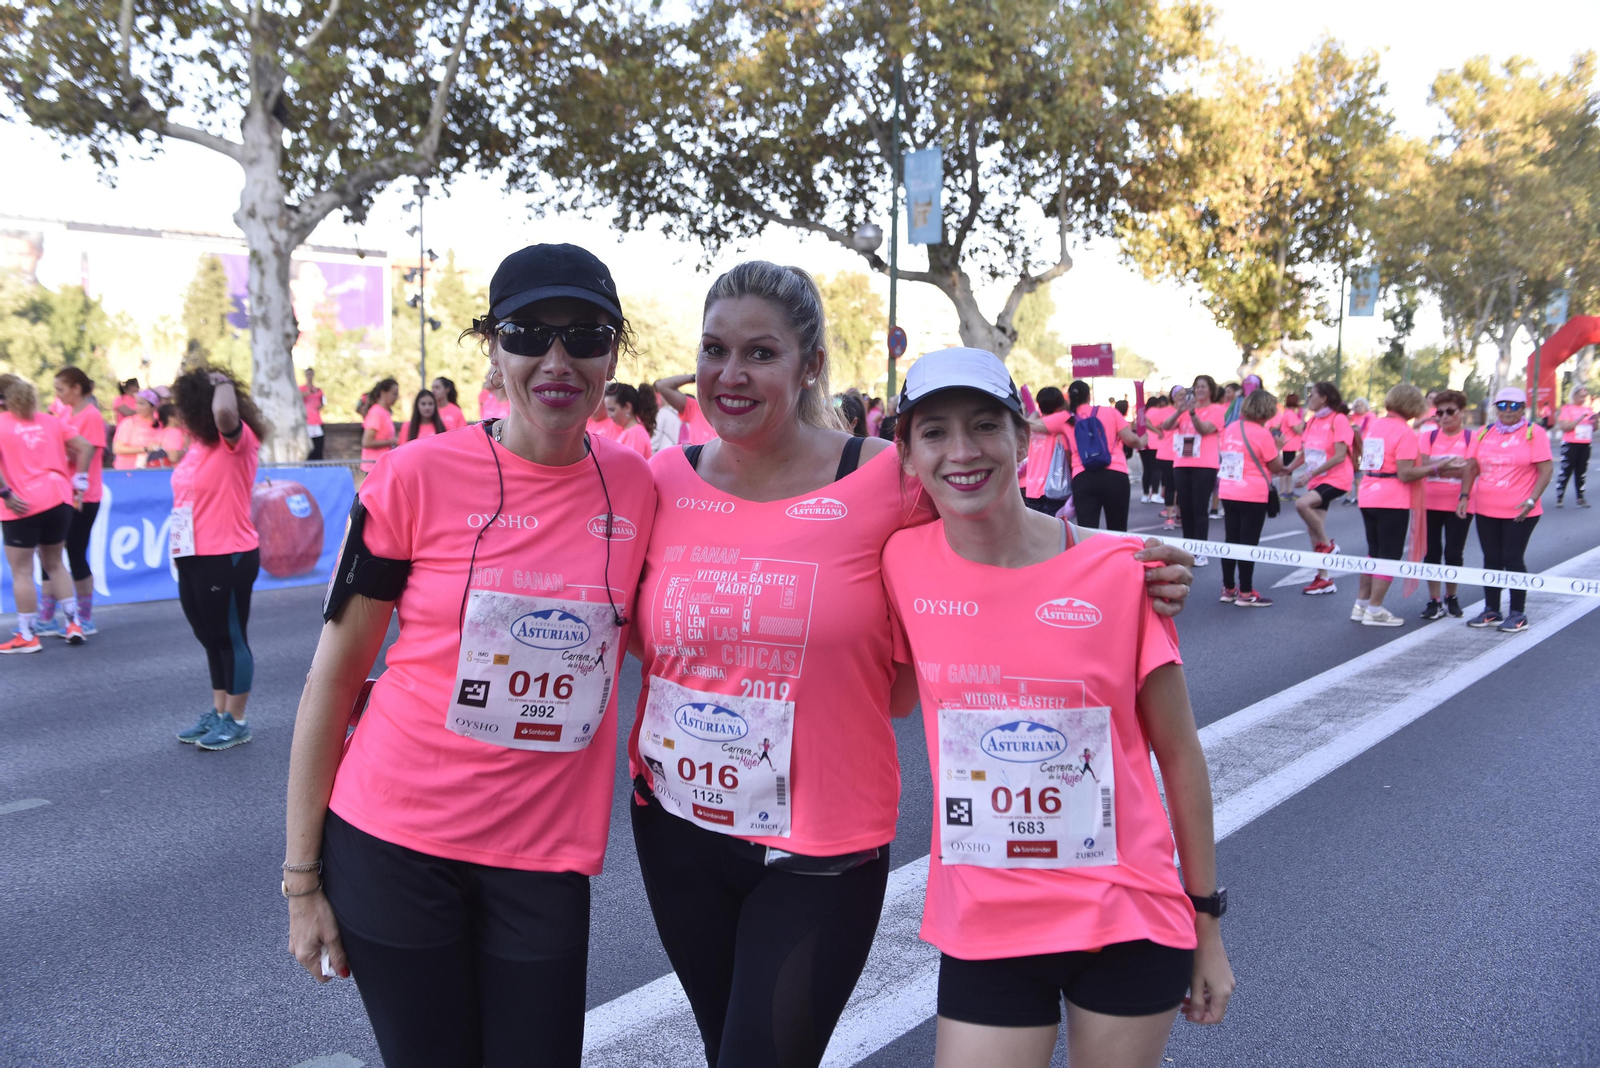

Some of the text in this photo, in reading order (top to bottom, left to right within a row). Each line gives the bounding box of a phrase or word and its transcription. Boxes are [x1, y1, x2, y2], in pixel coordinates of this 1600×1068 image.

[676, 497, 735, 514] OYSHO
[790, 506, 842, 516] ASTURIANA
[467, 513, 539, 530] OYSHO
[591, 521, 634, 536] ASTRIANA
[663, 545, 740, 564] HOY GANAN
[1183, 541, 1544, 589] OYSHO OYSHO OYSHO OYSHO OYSHO
[471, 567, 563, 592] HOY GANAN
[697, 570, 738, 582] VITORIA
[750, 573, 796, 586] GASTEIZ
[715, 582, 762, 596] MADRID
[720, 607, 730, 615] KM
[914, 598, 979, 617] OYSHO
[1041, 607, 1097, 623] ASTURIANA
[558, 622, 584, 630] LECHERA
[687, 617, 705, 628] LEN
[516, 622, 584, 642] ASTURIANA
[687, 628, 703, 640] CIA
[713, 626, 738, 641] LAS
[561, 650, 590, 663] Carrera
[721, 645, 797, 672] CHICAS
[576, 661, 597, 676] Mujer
[691, 665, 725, 679] CORUÑA
[947, 664, 1001, 685] GANAN
[508, 670, 575, 700] 016
[740, 678, 790, 700] 2019
[964, 693, 1008, 707] VITORIA
[1019, 696, 1066, 709] GASTEIZ
[520, 704, 555, 718] 2992
[455, 717, 499, 733] OYSHO
[679, 710, 742, 736] ASTURIANA
[528, 728, 556, 736] Santander
[721, 743, 752, 756] Carrera
[987, 736, 1061, 752] ASTURIANA
[739, 754, 761, 770] Mujer
[1039, 762, 1074, 773] Carrera
[677, 757, 739, 790] 016
[1060, 773, 1084, 787] Mujer
[656, 784, 682, 807] OYSO
[692, 789, 723, 804] 1125
[991, 786, 1062, 814] 016
[702, 811, 728, 821] Santander
[1008, 821, 1045, 834] 1683
[950, 841, 990, 853] OYSHO
[1075, 851, 1104, 859] ZURICH
